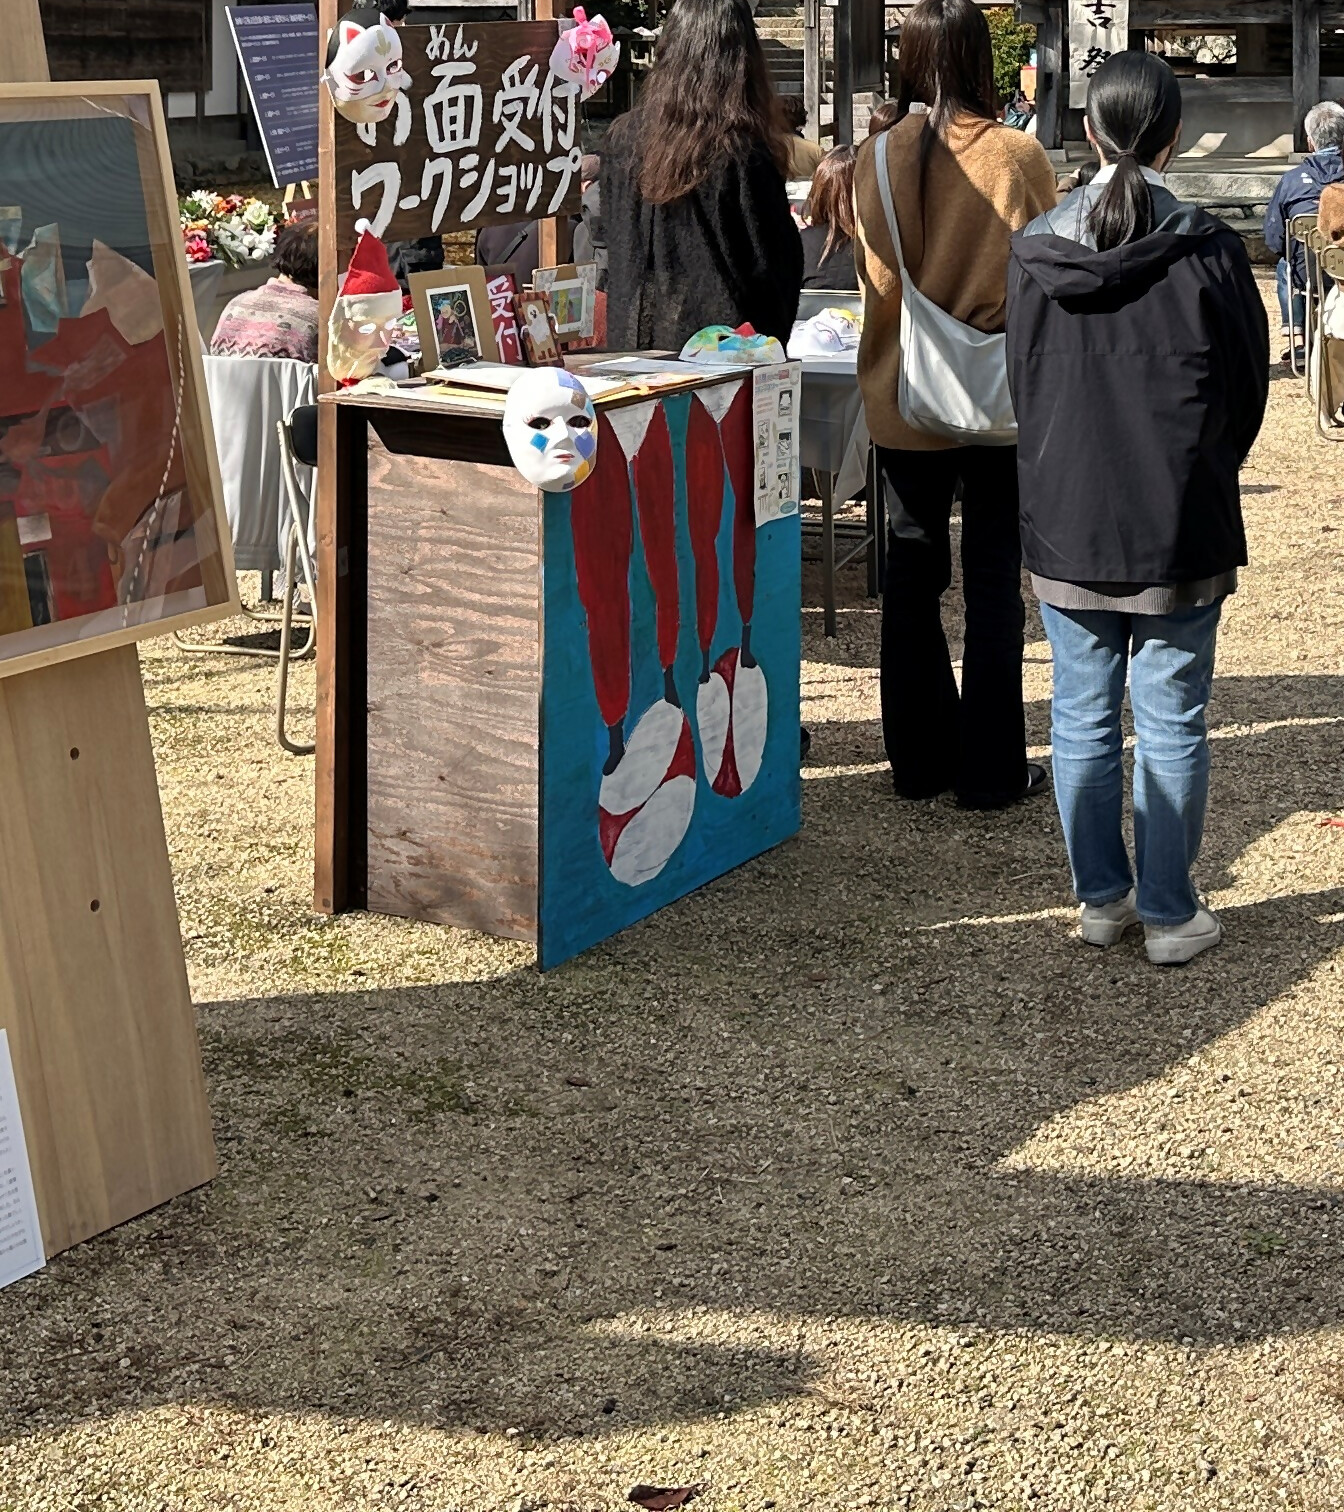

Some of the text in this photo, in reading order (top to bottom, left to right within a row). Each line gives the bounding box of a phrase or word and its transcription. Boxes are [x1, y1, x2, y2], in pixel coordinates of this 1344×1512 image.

[425, 24, 479, 61] めん
[351, 146, 583, 239] ワークショップ
[486, 275, 523, 363] 受付
